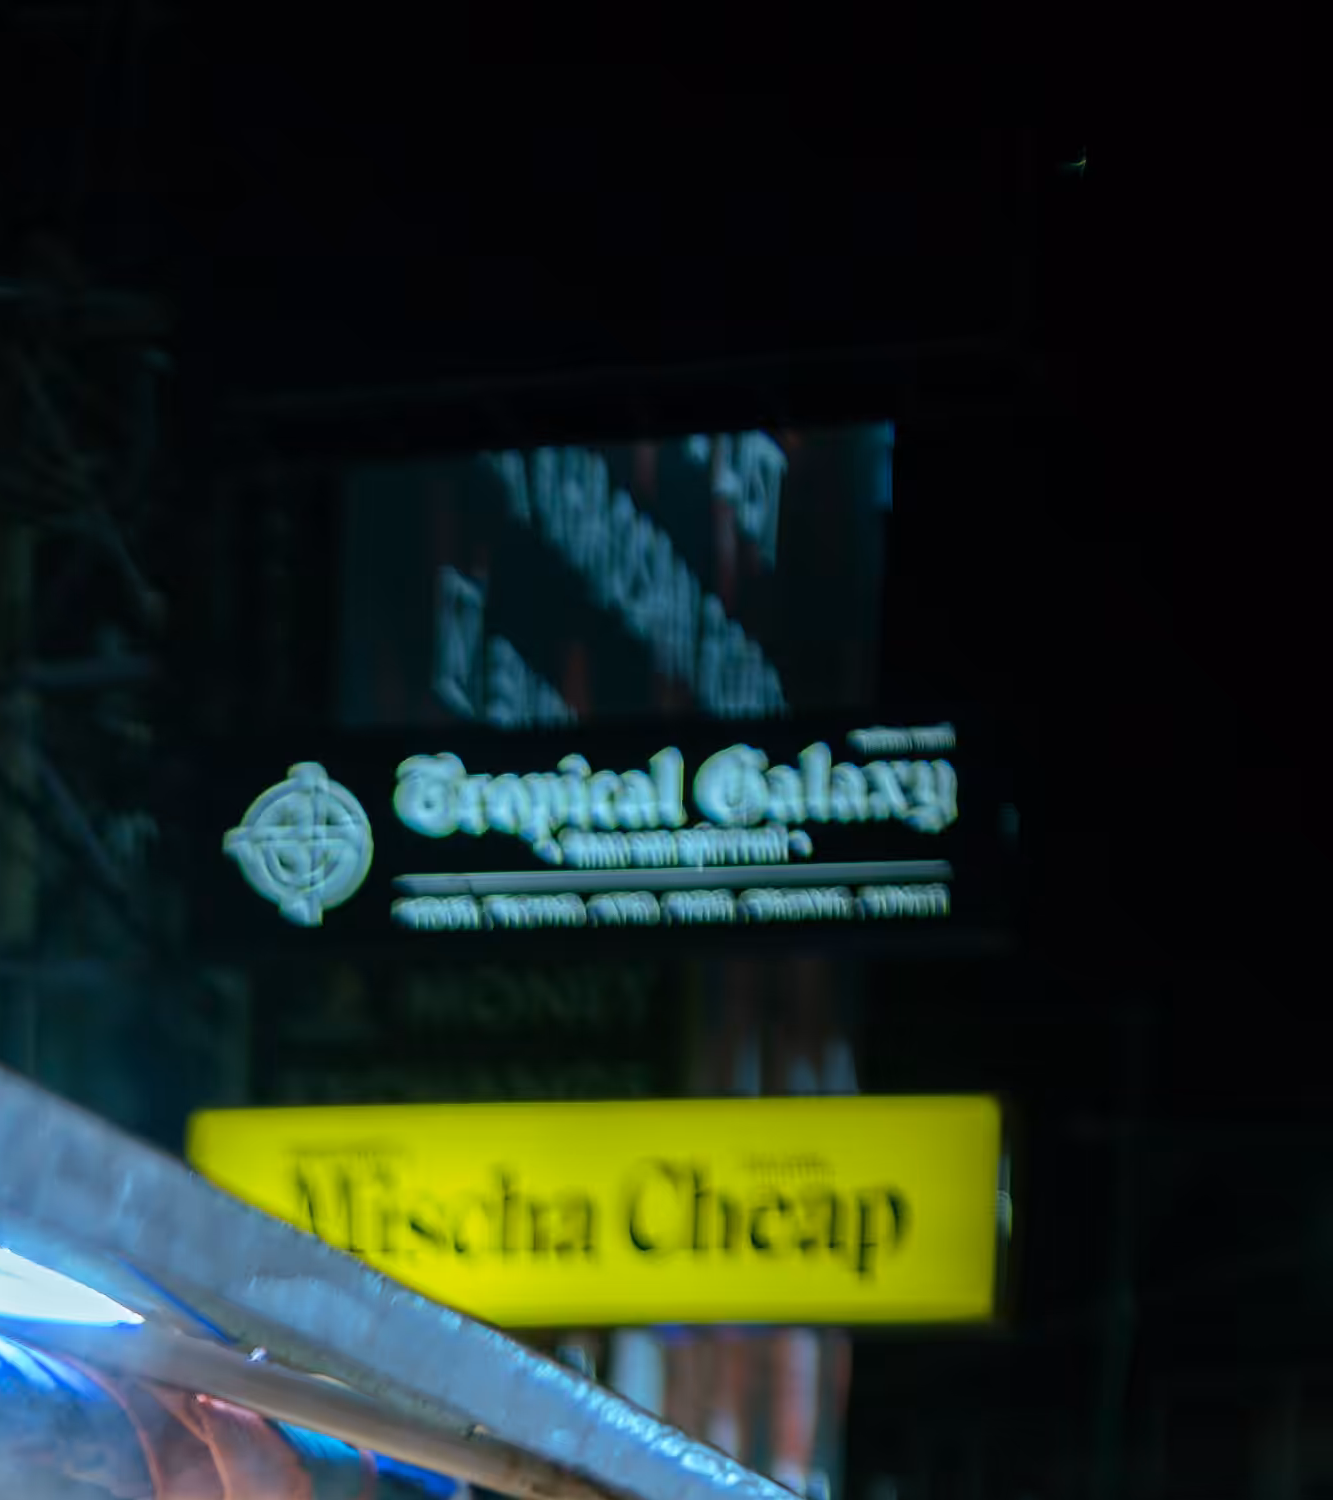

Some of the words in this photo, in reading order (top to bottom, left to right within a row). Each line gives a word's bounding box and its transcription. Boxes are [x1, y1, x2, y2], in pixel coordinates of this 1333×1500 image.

[392, 746, 687, 866] Tropical
[694, 741, 958, 833] Galaxy
[623, 1154, 911, 1280] Cheap
